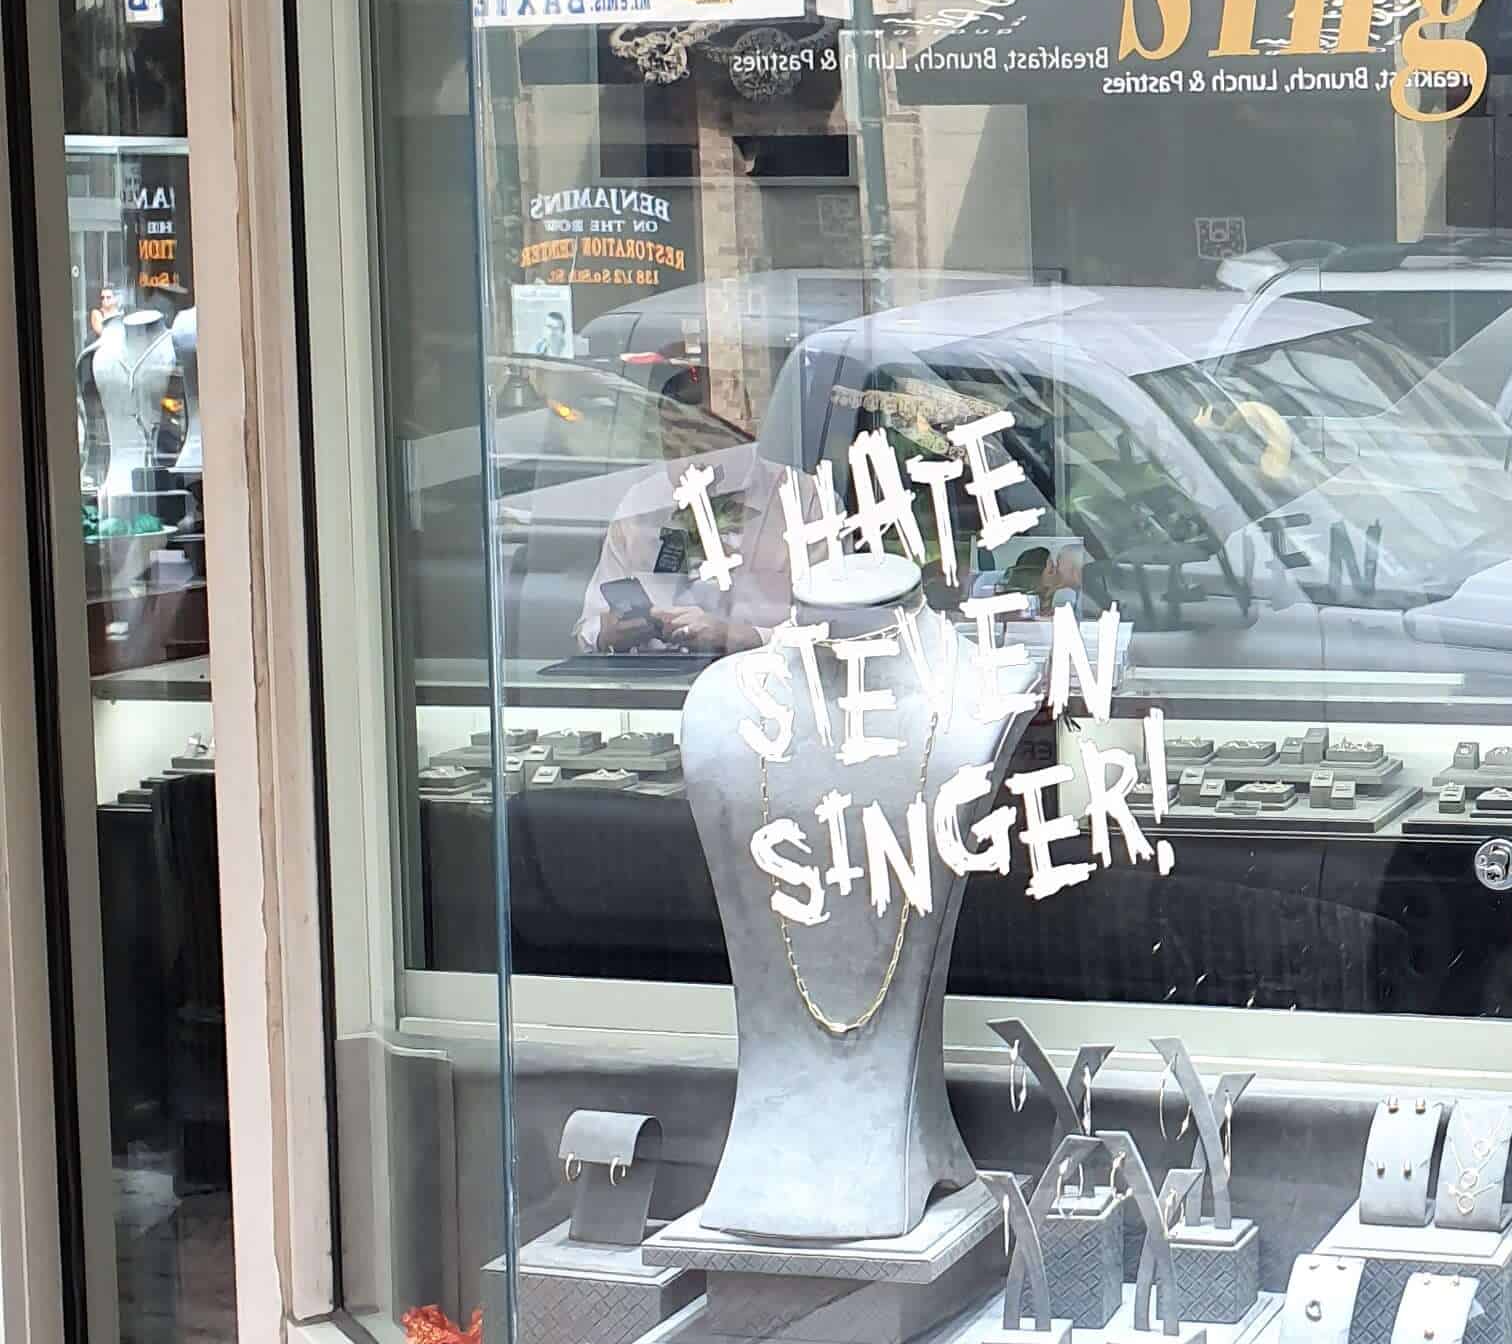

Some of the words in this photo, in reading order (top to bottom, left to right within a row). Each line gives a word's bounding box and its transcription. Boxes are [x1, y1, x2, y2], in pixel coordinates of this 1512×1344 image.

[673, 463, 743, 591] I
[779, 411, 1047, 595] HATE
[736, 591, 1121, 765] STEVEN
[750, 706, 1176, 925] SINGER!
